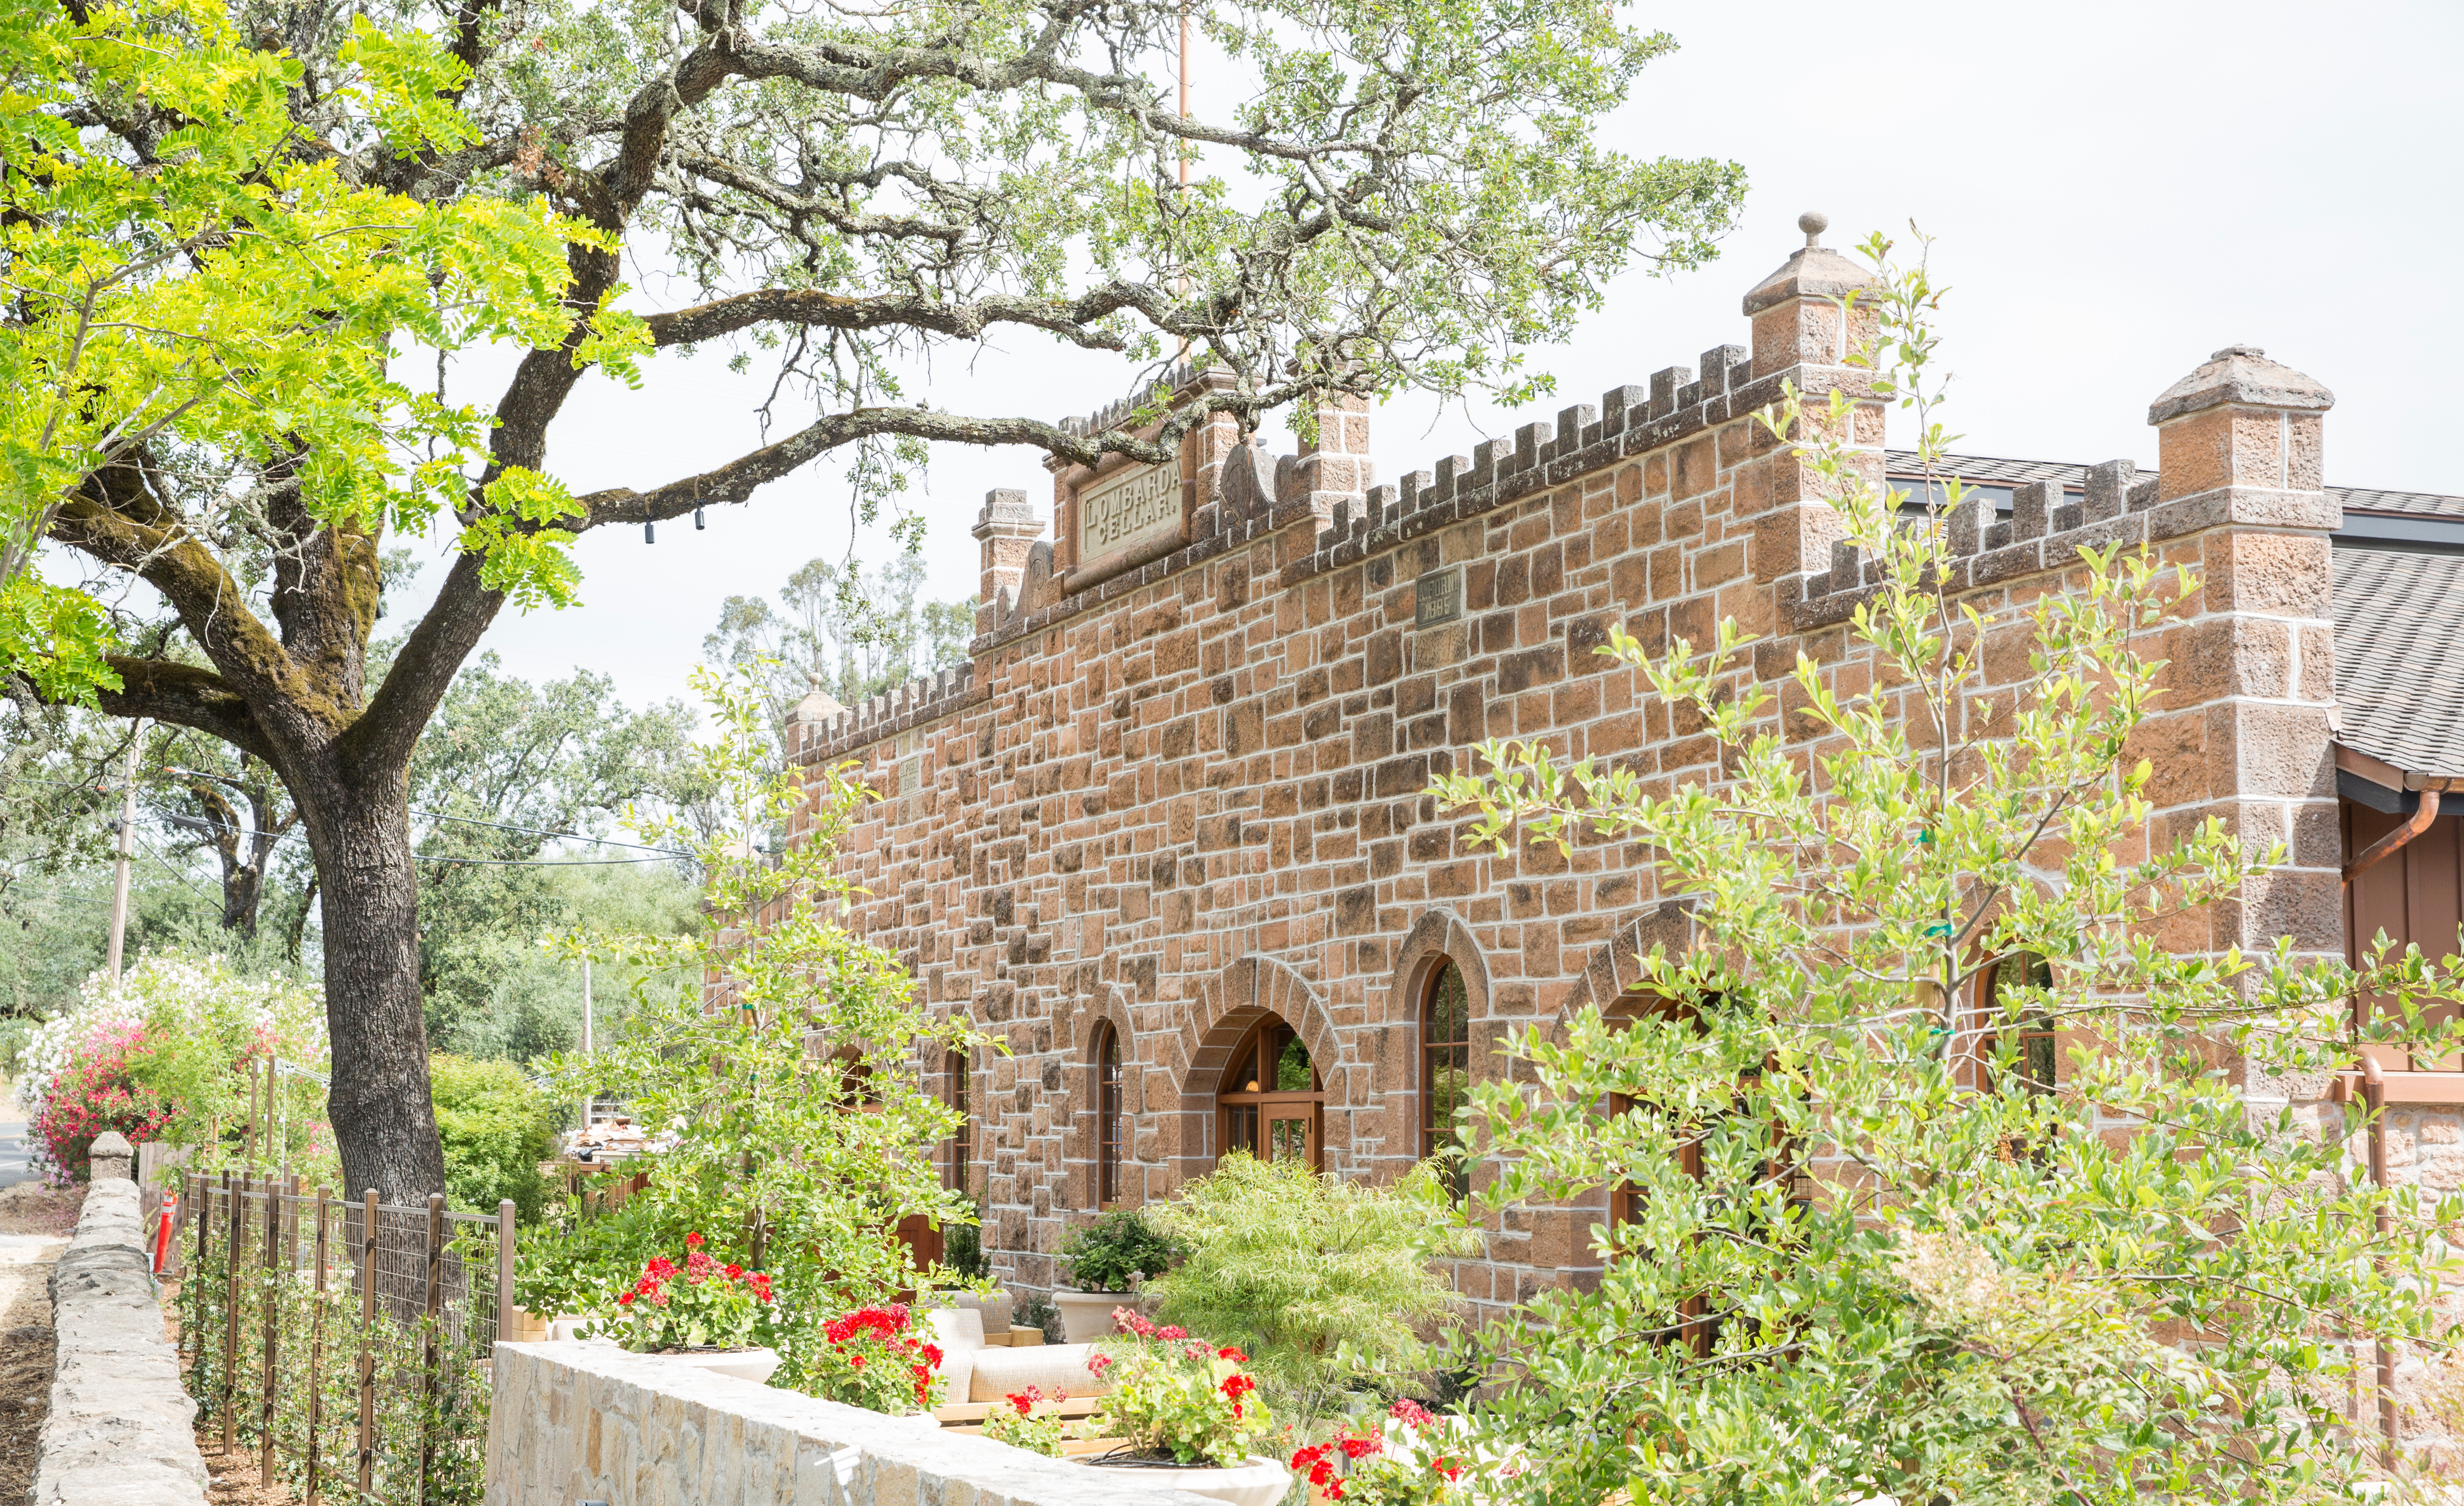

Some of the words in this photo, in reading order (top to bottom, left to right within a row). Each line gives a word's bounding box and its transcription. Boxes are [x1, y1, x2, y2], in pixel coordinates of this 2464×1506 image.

[1086, 460, 1182, 528] LOMBARDA
[1428, 574, 1458, 599] FORNI
[1423, 596, 1451, 619] 1895
